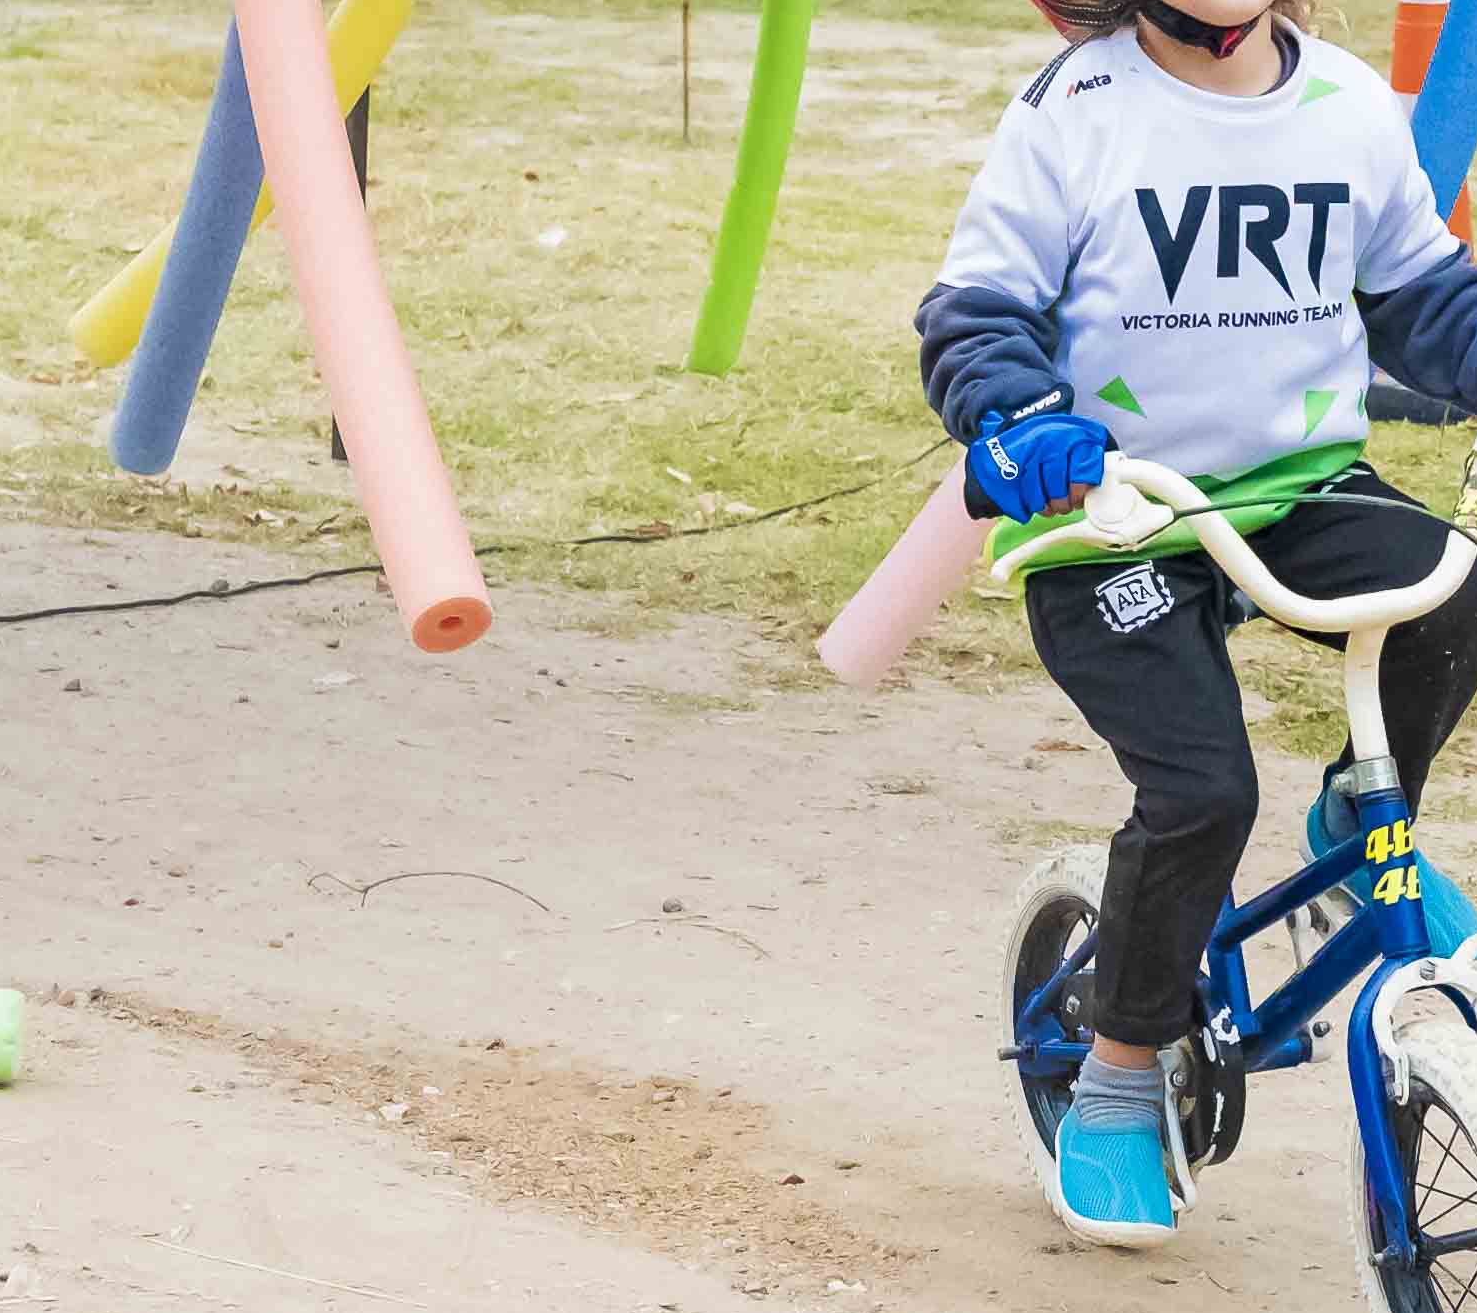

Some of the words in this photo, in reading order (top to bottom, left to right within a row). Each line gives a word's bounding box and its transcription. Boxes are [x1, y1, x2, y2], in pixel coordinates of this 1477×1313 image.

[1134, 182, 1350, 306] VRT
[1121, 312, 1212, 331] VICTORIA
[1217, 309, 1299, 328] RUNNING
[1302, 302, 1343, 322] TEAM
[1110, 577, 1156, 612] AFA
[1365, 819, 1414, 864] 46
